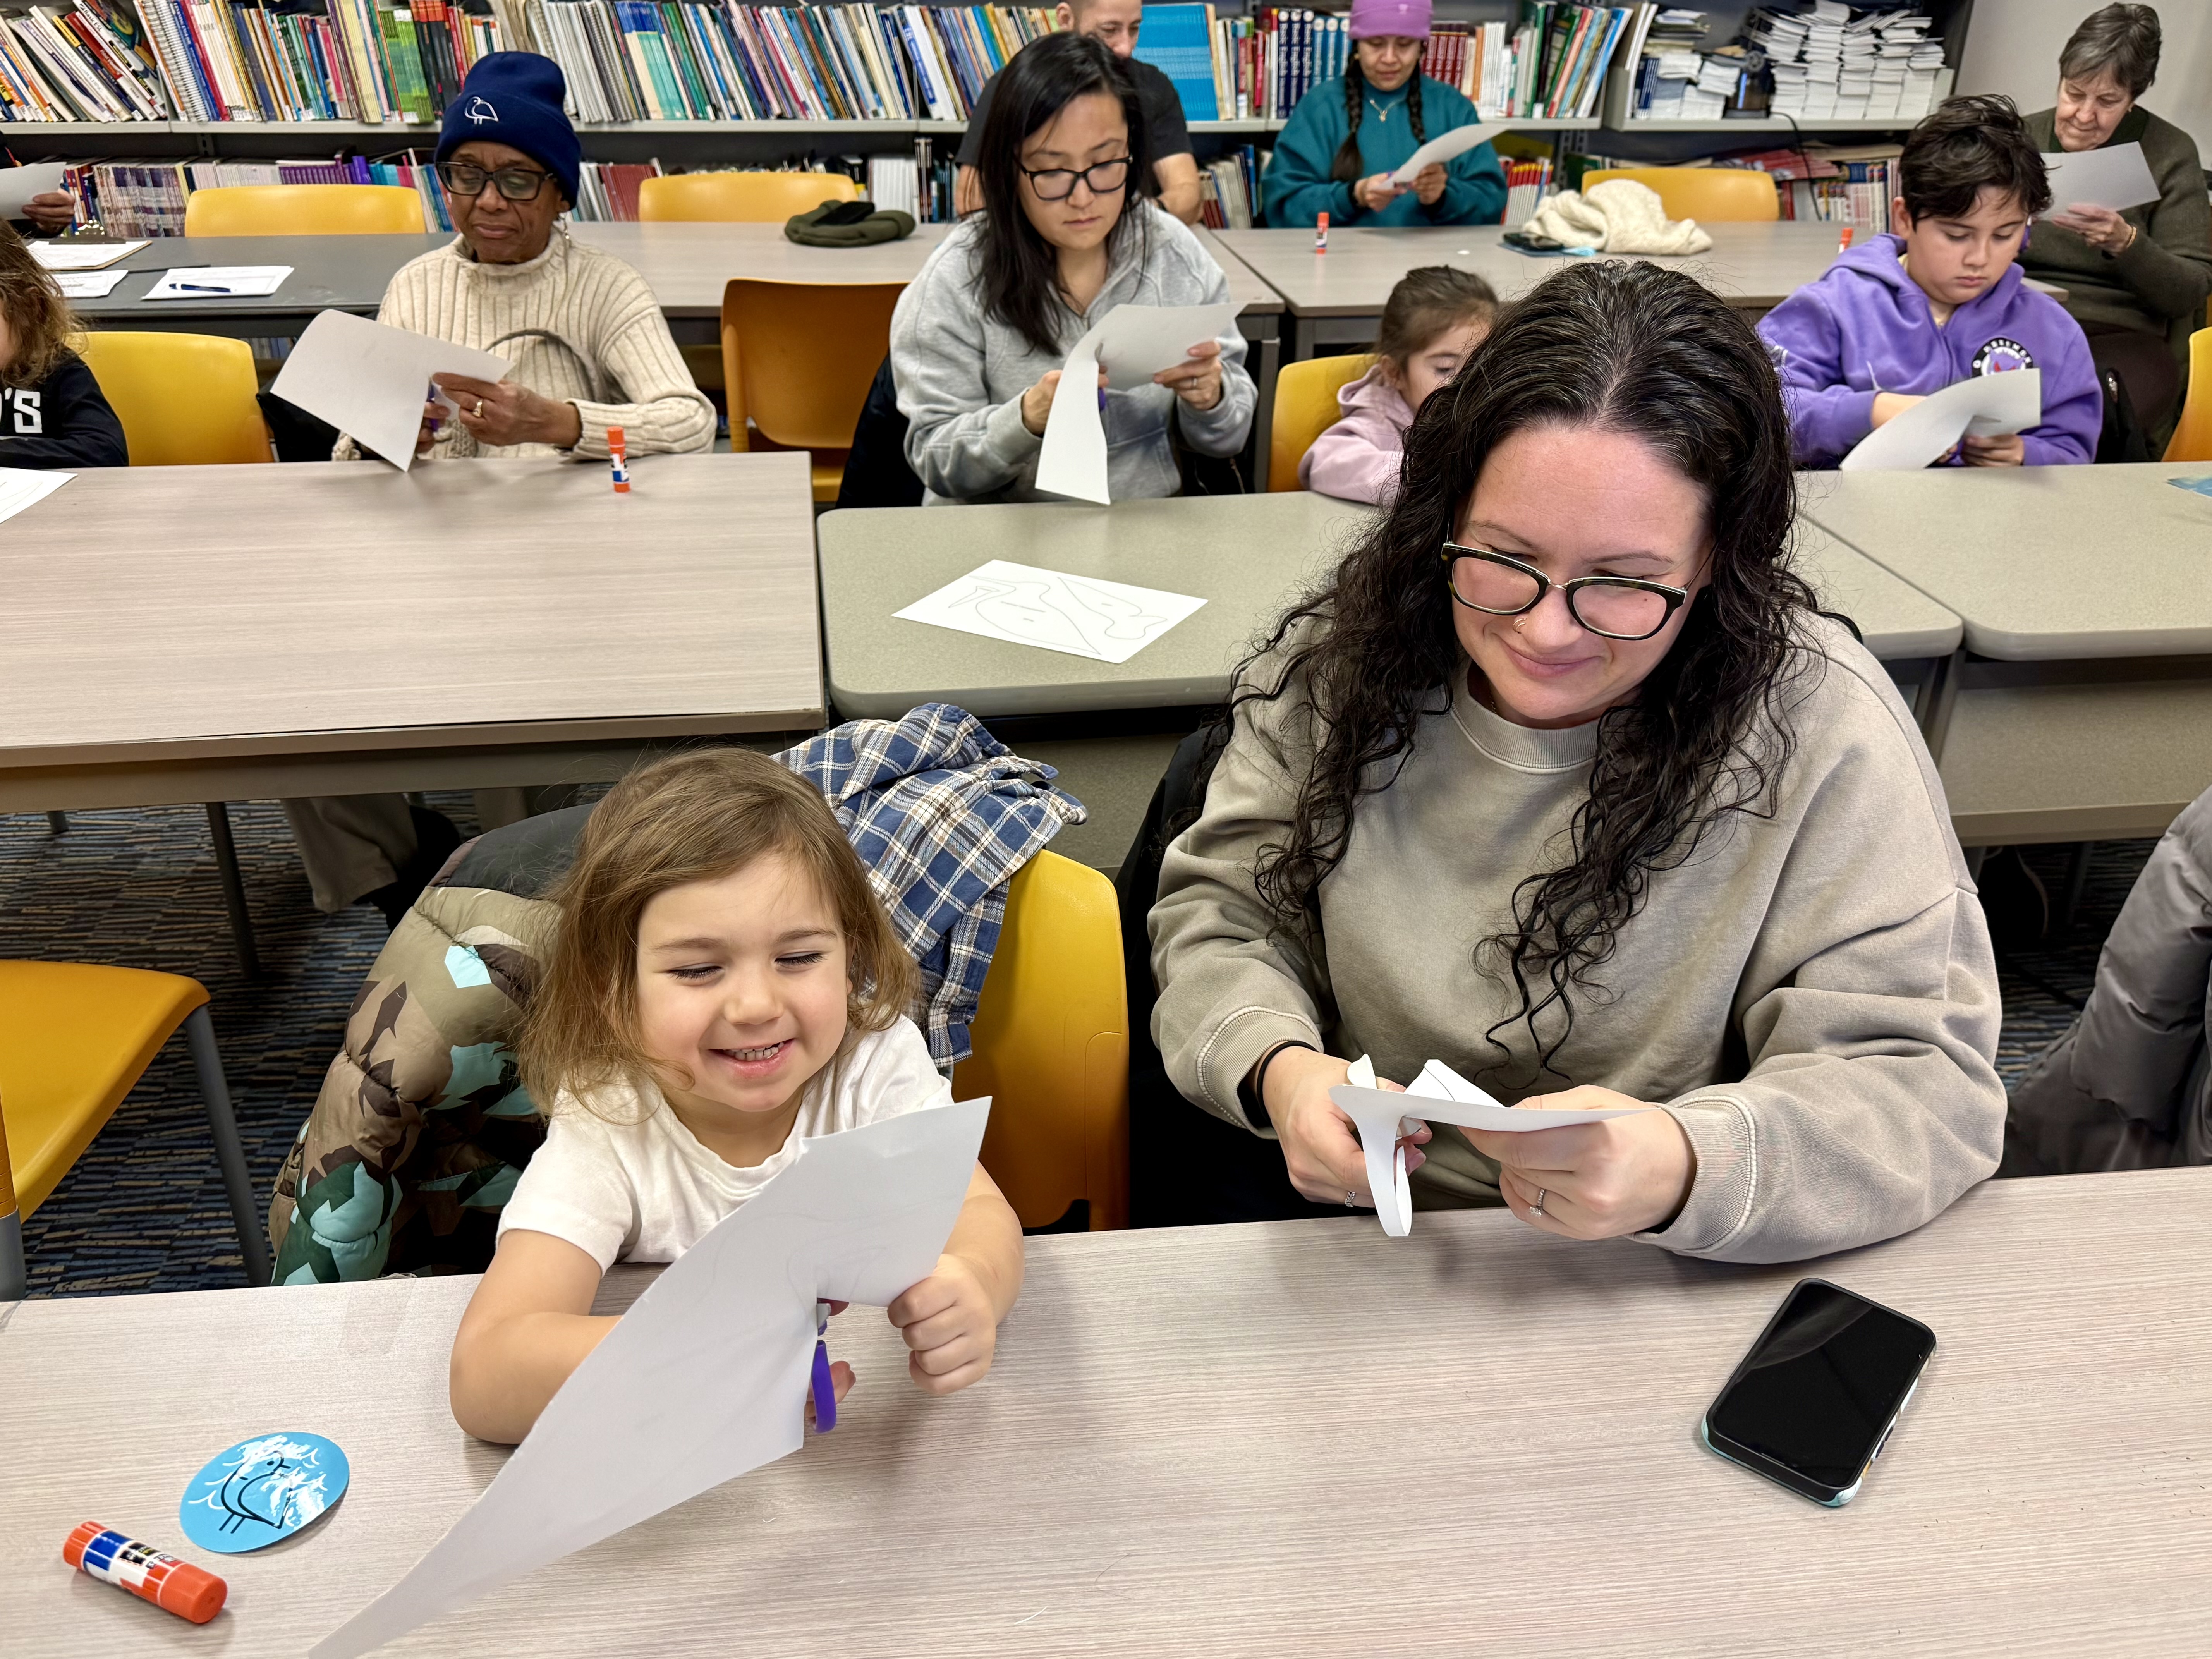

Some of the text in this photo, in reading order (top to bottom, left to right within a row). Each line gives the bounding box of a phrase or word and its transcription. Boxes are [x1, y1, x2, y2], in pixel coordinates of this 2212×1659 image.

[84, 9, 103, 32] Basic ESL
[1279, 47, 1288, 76] English
[1290, 47, 1300, 76] English
[1302, 47, 1312, 76] English
[0, 387, 42, 433] 'S
